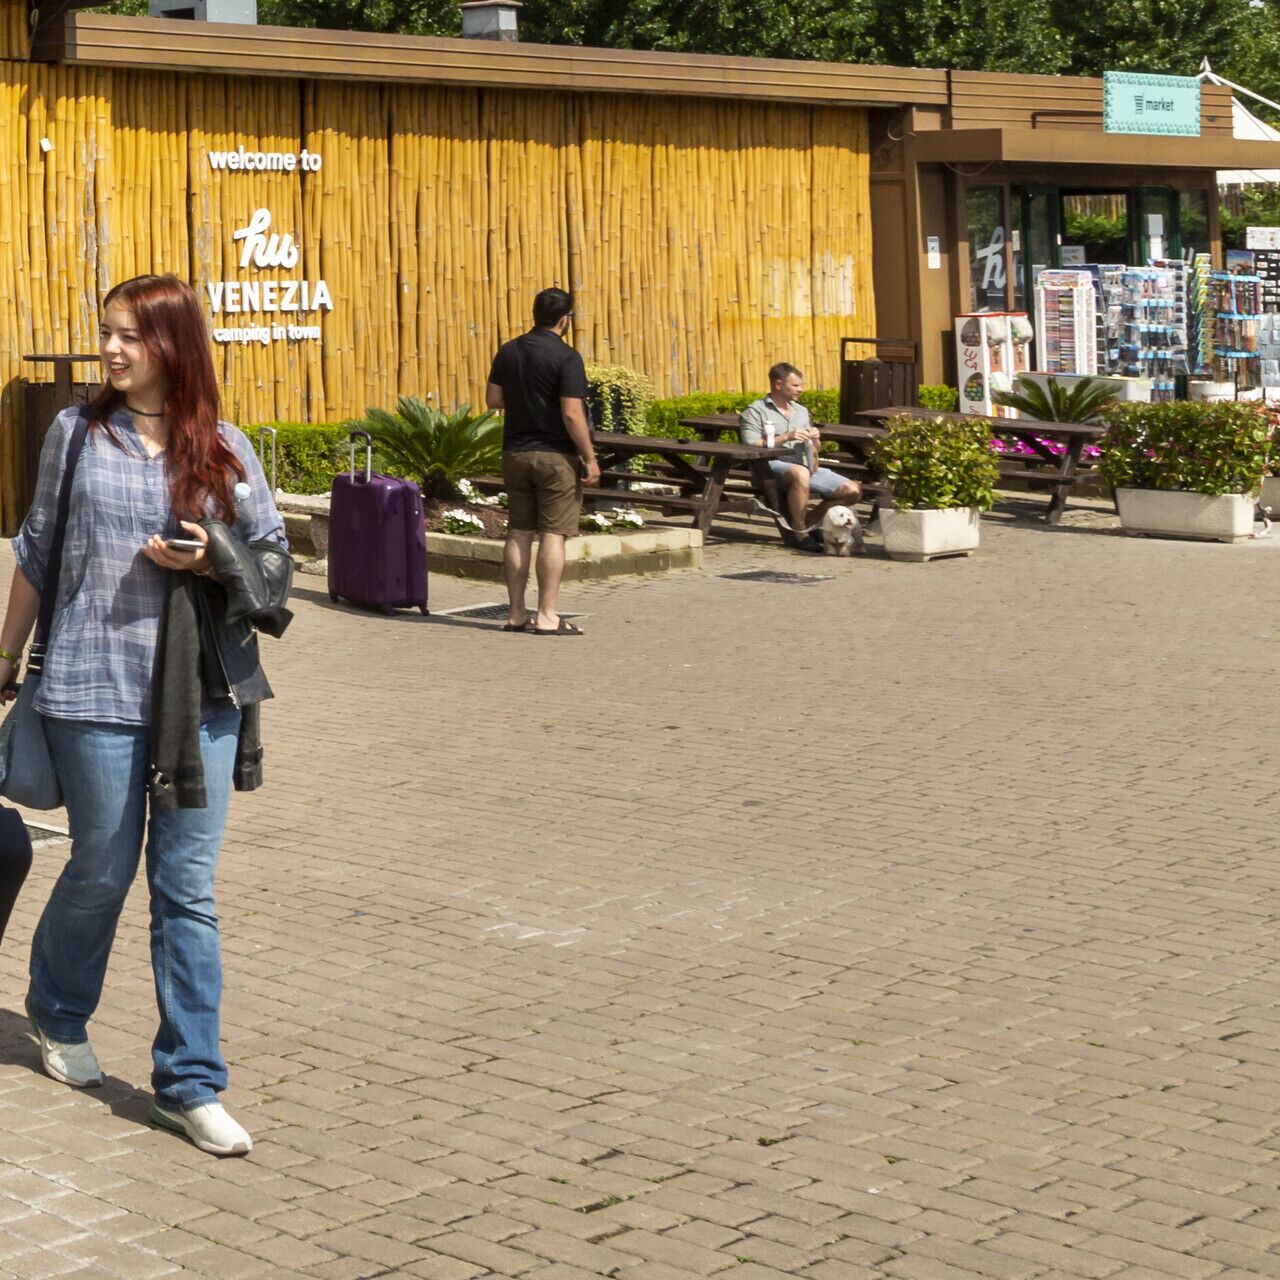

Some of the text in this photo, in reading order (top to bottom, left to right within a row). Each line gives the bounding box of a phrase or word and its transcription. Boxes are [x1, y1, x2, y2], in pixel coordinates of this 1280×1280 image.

[1146, 97, 1174, 112] market
[209, 145, 322, 171] welcome to
[233, 207, 299, 269] hu
[207, 280, 334, 313] VENEZIA
[213, 322, 320, 345] camping in town
